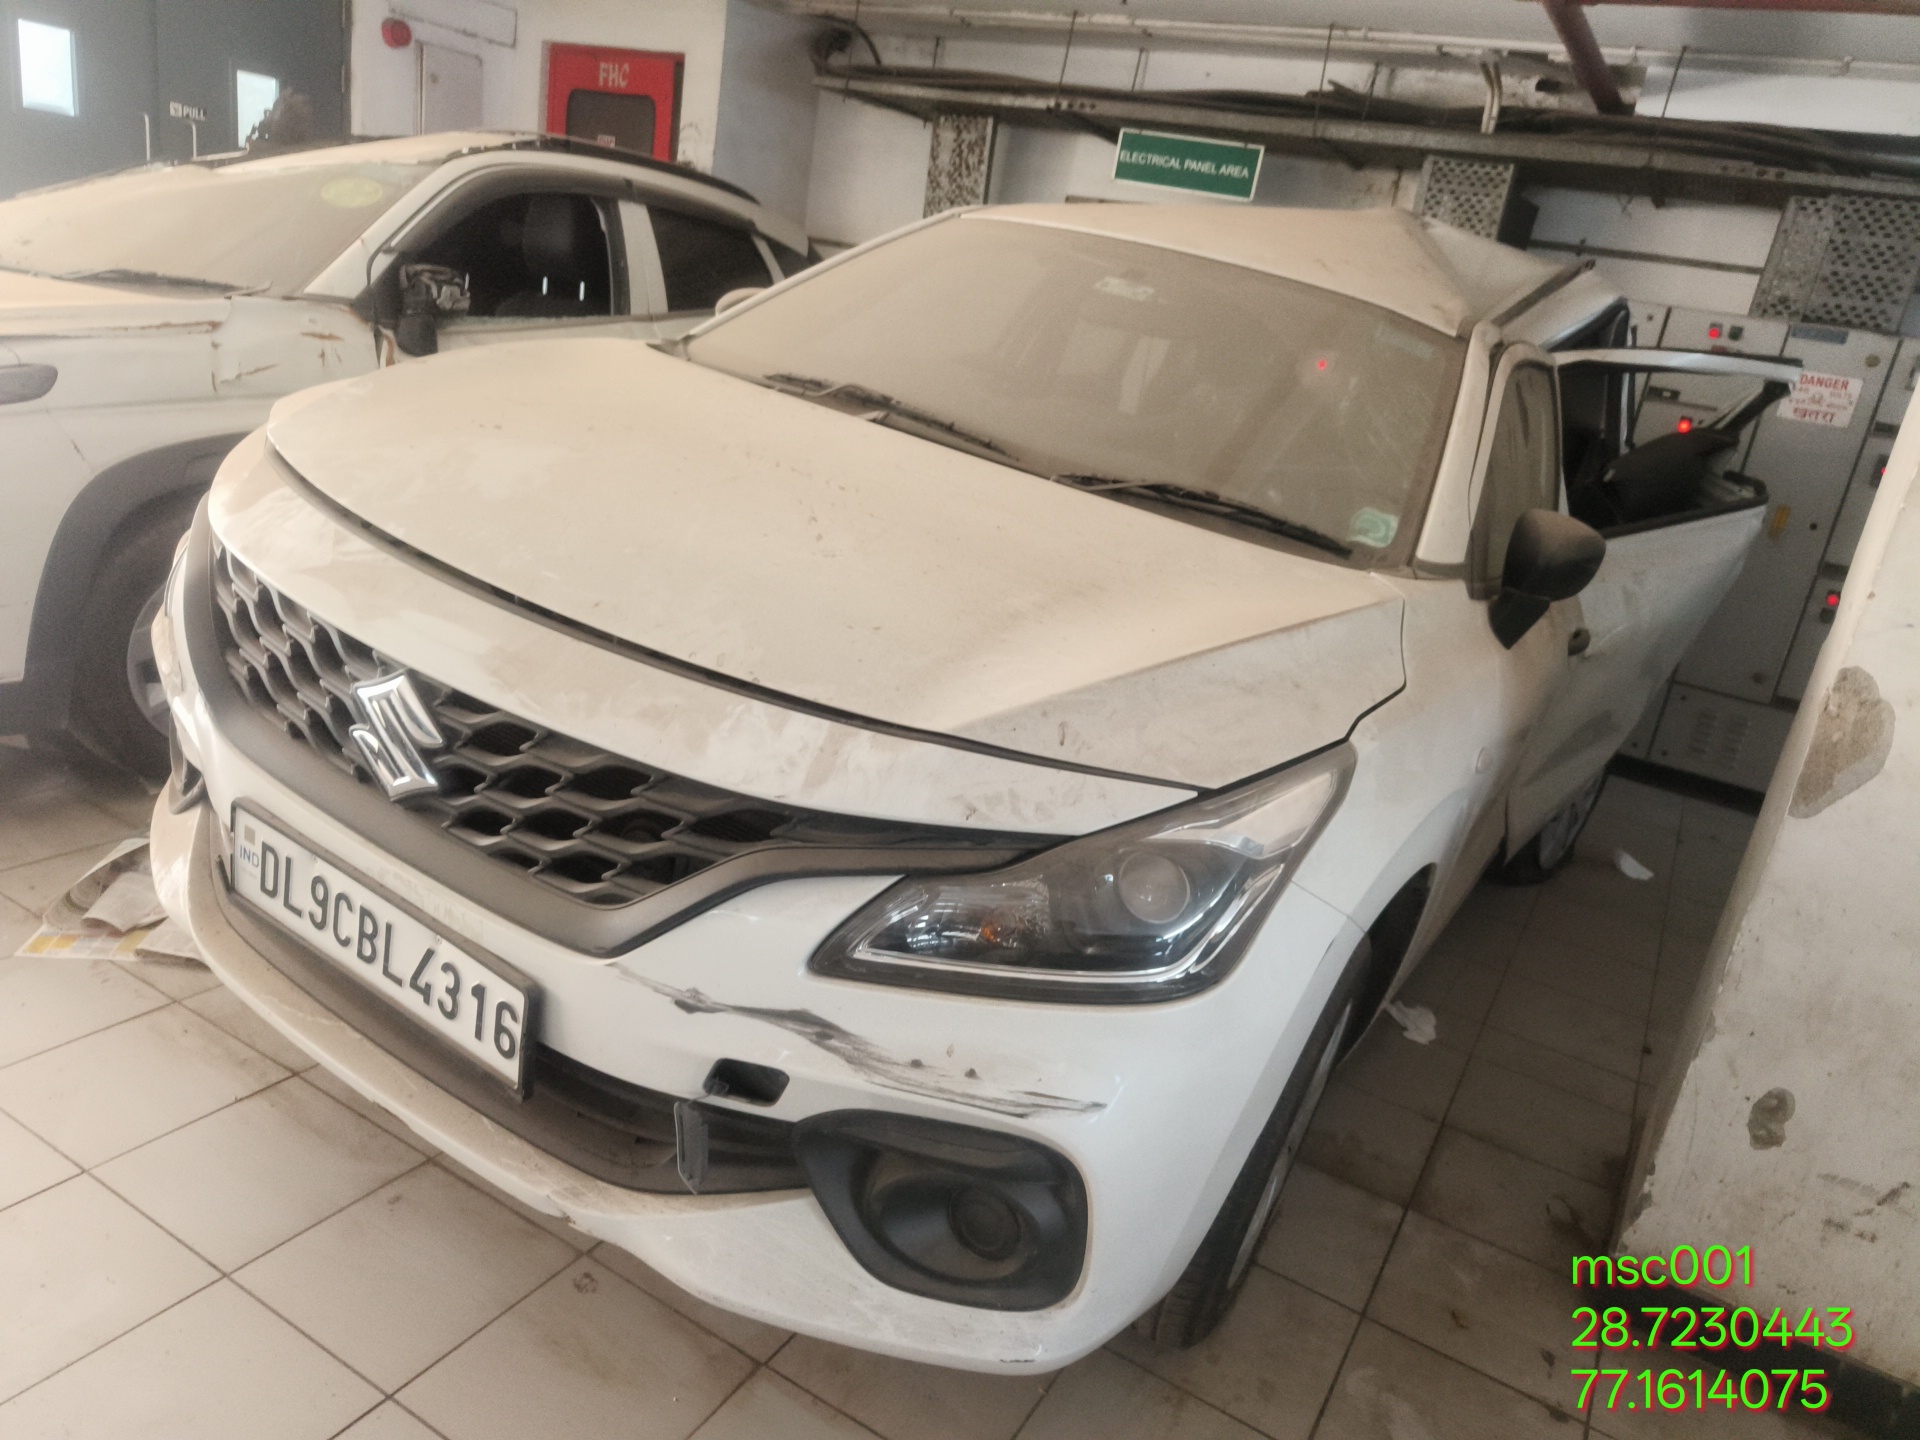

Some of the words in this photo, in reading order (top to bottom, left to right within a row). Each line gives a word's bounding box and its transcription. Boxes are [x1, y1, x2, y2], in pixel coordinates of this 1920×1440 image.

[598, 62, 630, 88] FHC
[183, 105, 206, 121] PULL
[1119, 150, 1181, 170] ELECTRICAL
[1183, 159, 1217, 174] PANEL
[1219, 164, 1249, 179] AREA
[1800, 373, 1849, 390] DANGER
[260, 841, 519, 1059] DL9CBL4316
